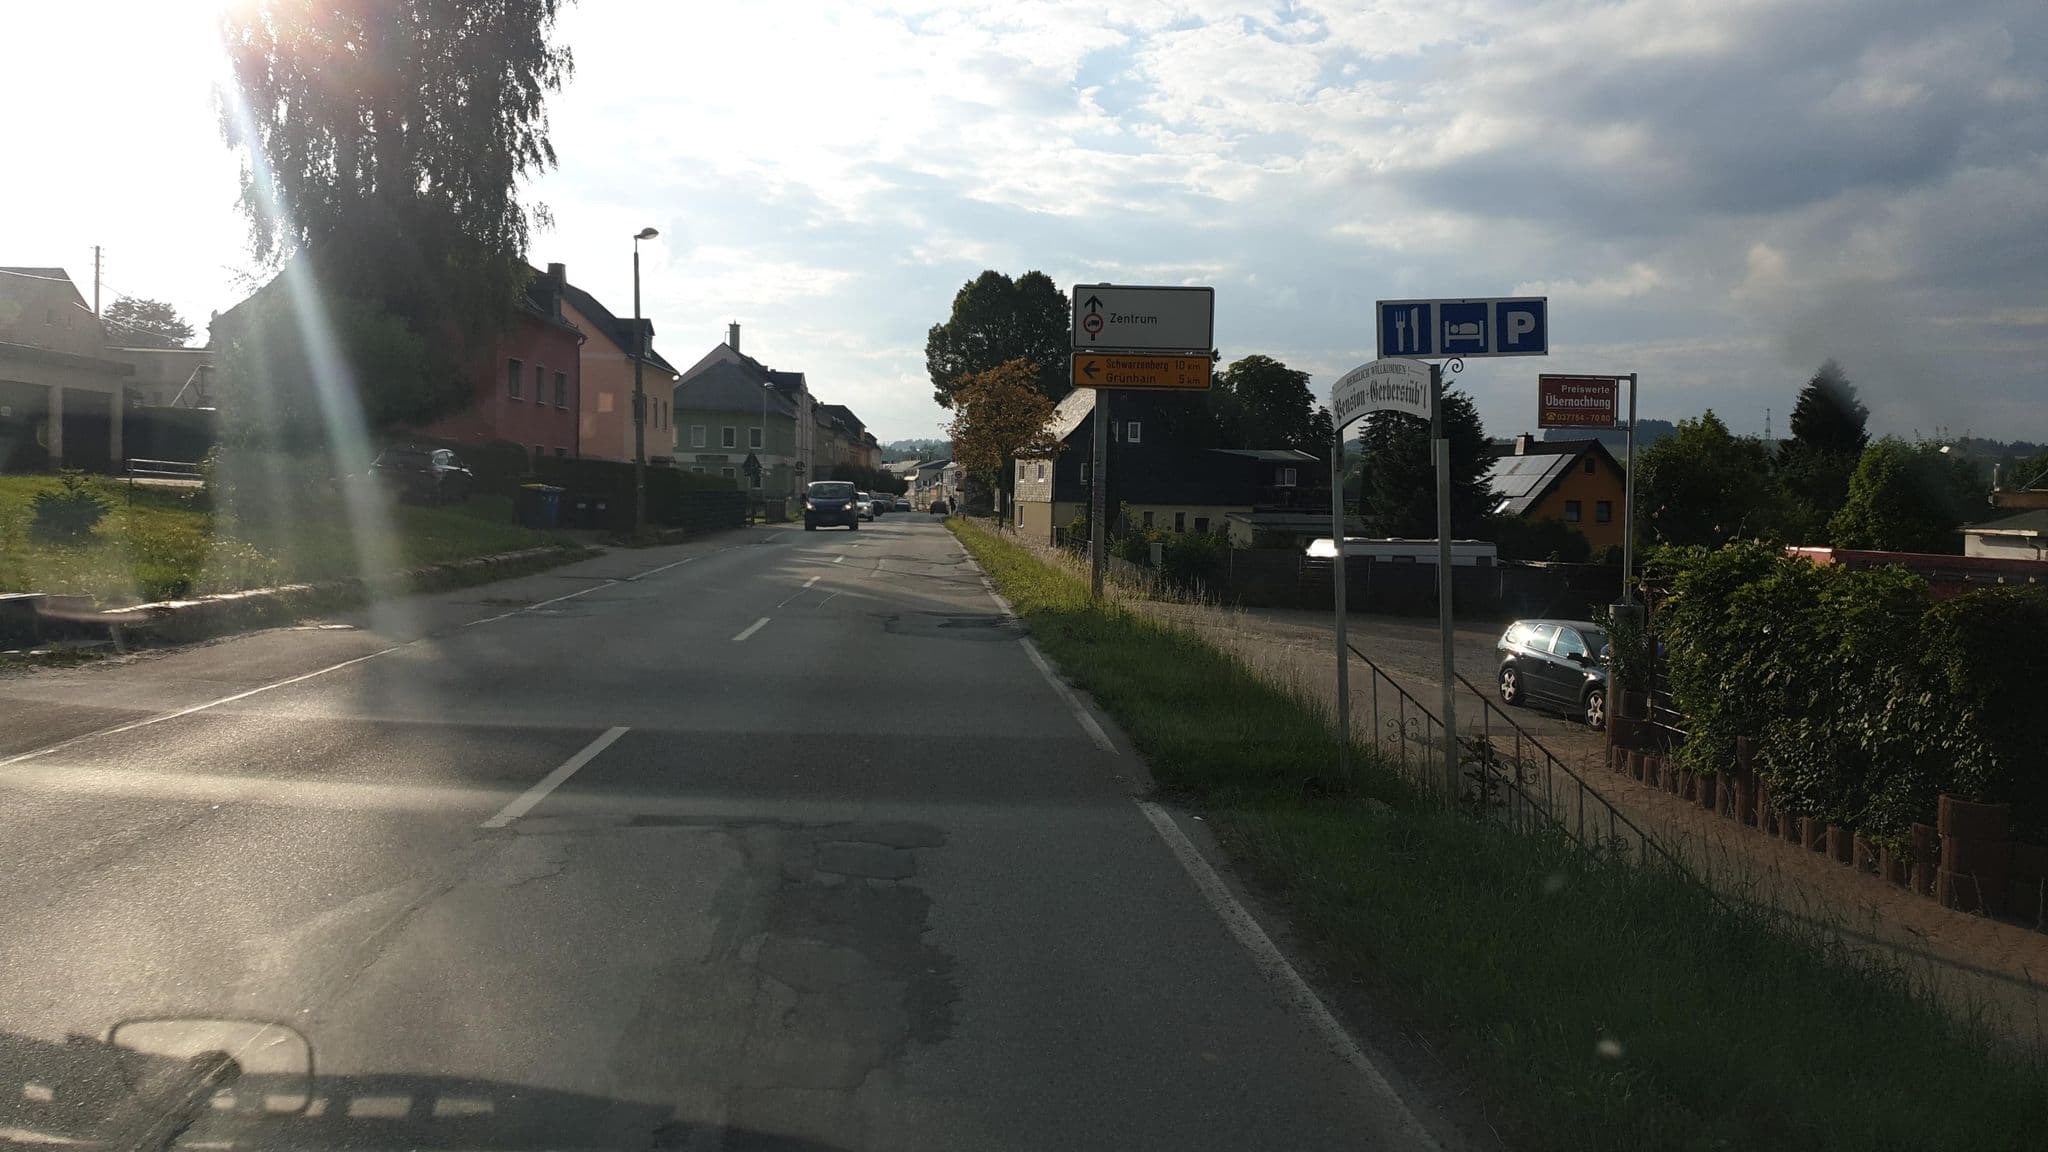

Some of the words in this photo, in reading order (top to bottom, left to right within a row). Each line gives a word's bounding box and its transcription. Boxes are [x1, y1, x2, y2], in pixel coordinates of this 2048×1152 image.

[1110, 313, 1157, 324] Zentrum
[1507, 311, 1536, 344] P
[1105, 359, 1169, 372] Schwarzenberg
[1175, 360, 1185, 370] 10
[1178, 374, 1185, 384] 5
[1187, 376, 1201, 385] km
[1561, 384, 1610, 394] Preiswerte
[1545, 392, 1611, 410] Übernachtung
